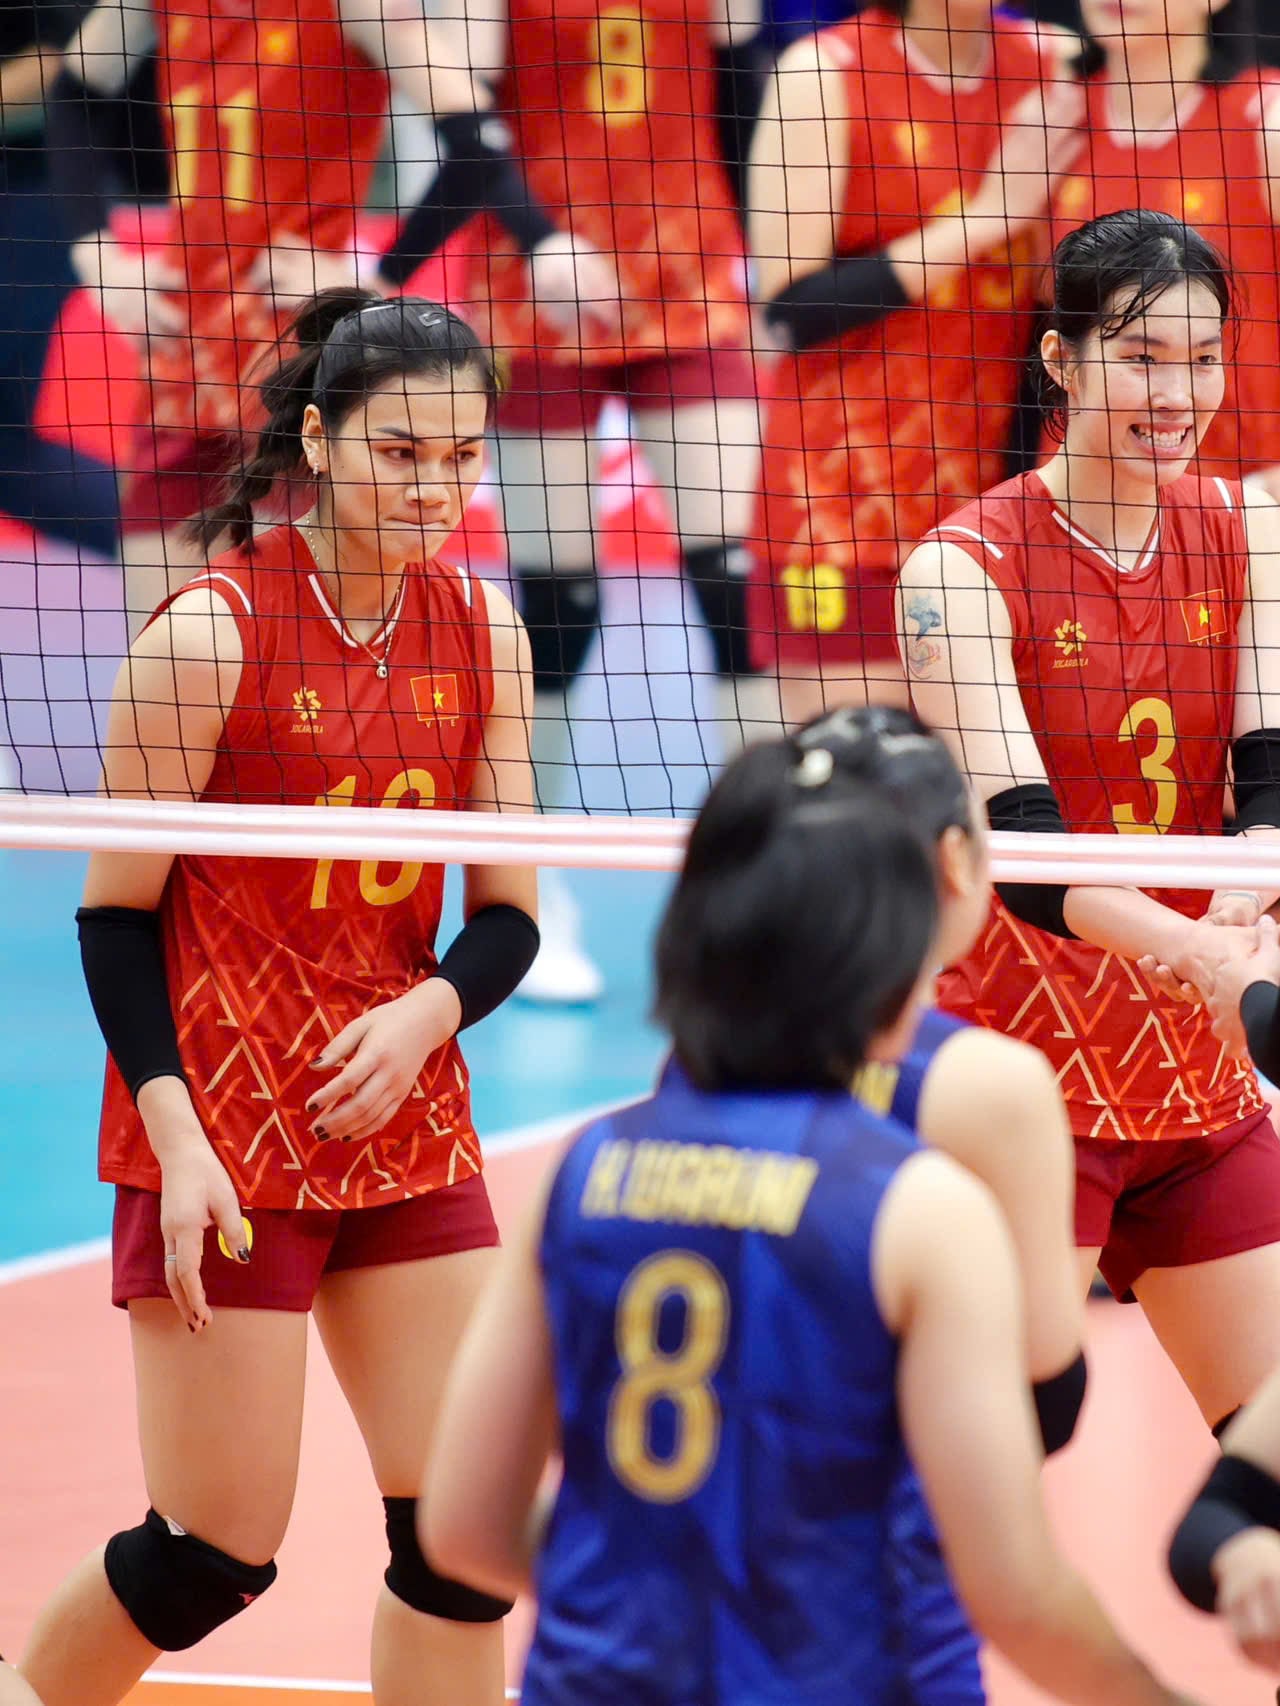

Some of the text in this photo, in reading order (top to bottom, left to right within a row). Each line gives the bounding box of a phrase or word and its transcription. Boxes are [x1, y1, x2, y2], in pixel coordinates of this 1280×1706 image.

[585, 5, 656, 126] 8
[164, 84, 256, 212] 11
[1112, 697, 1177, 835] 3
[607, 1248, 730, 1504] 8
